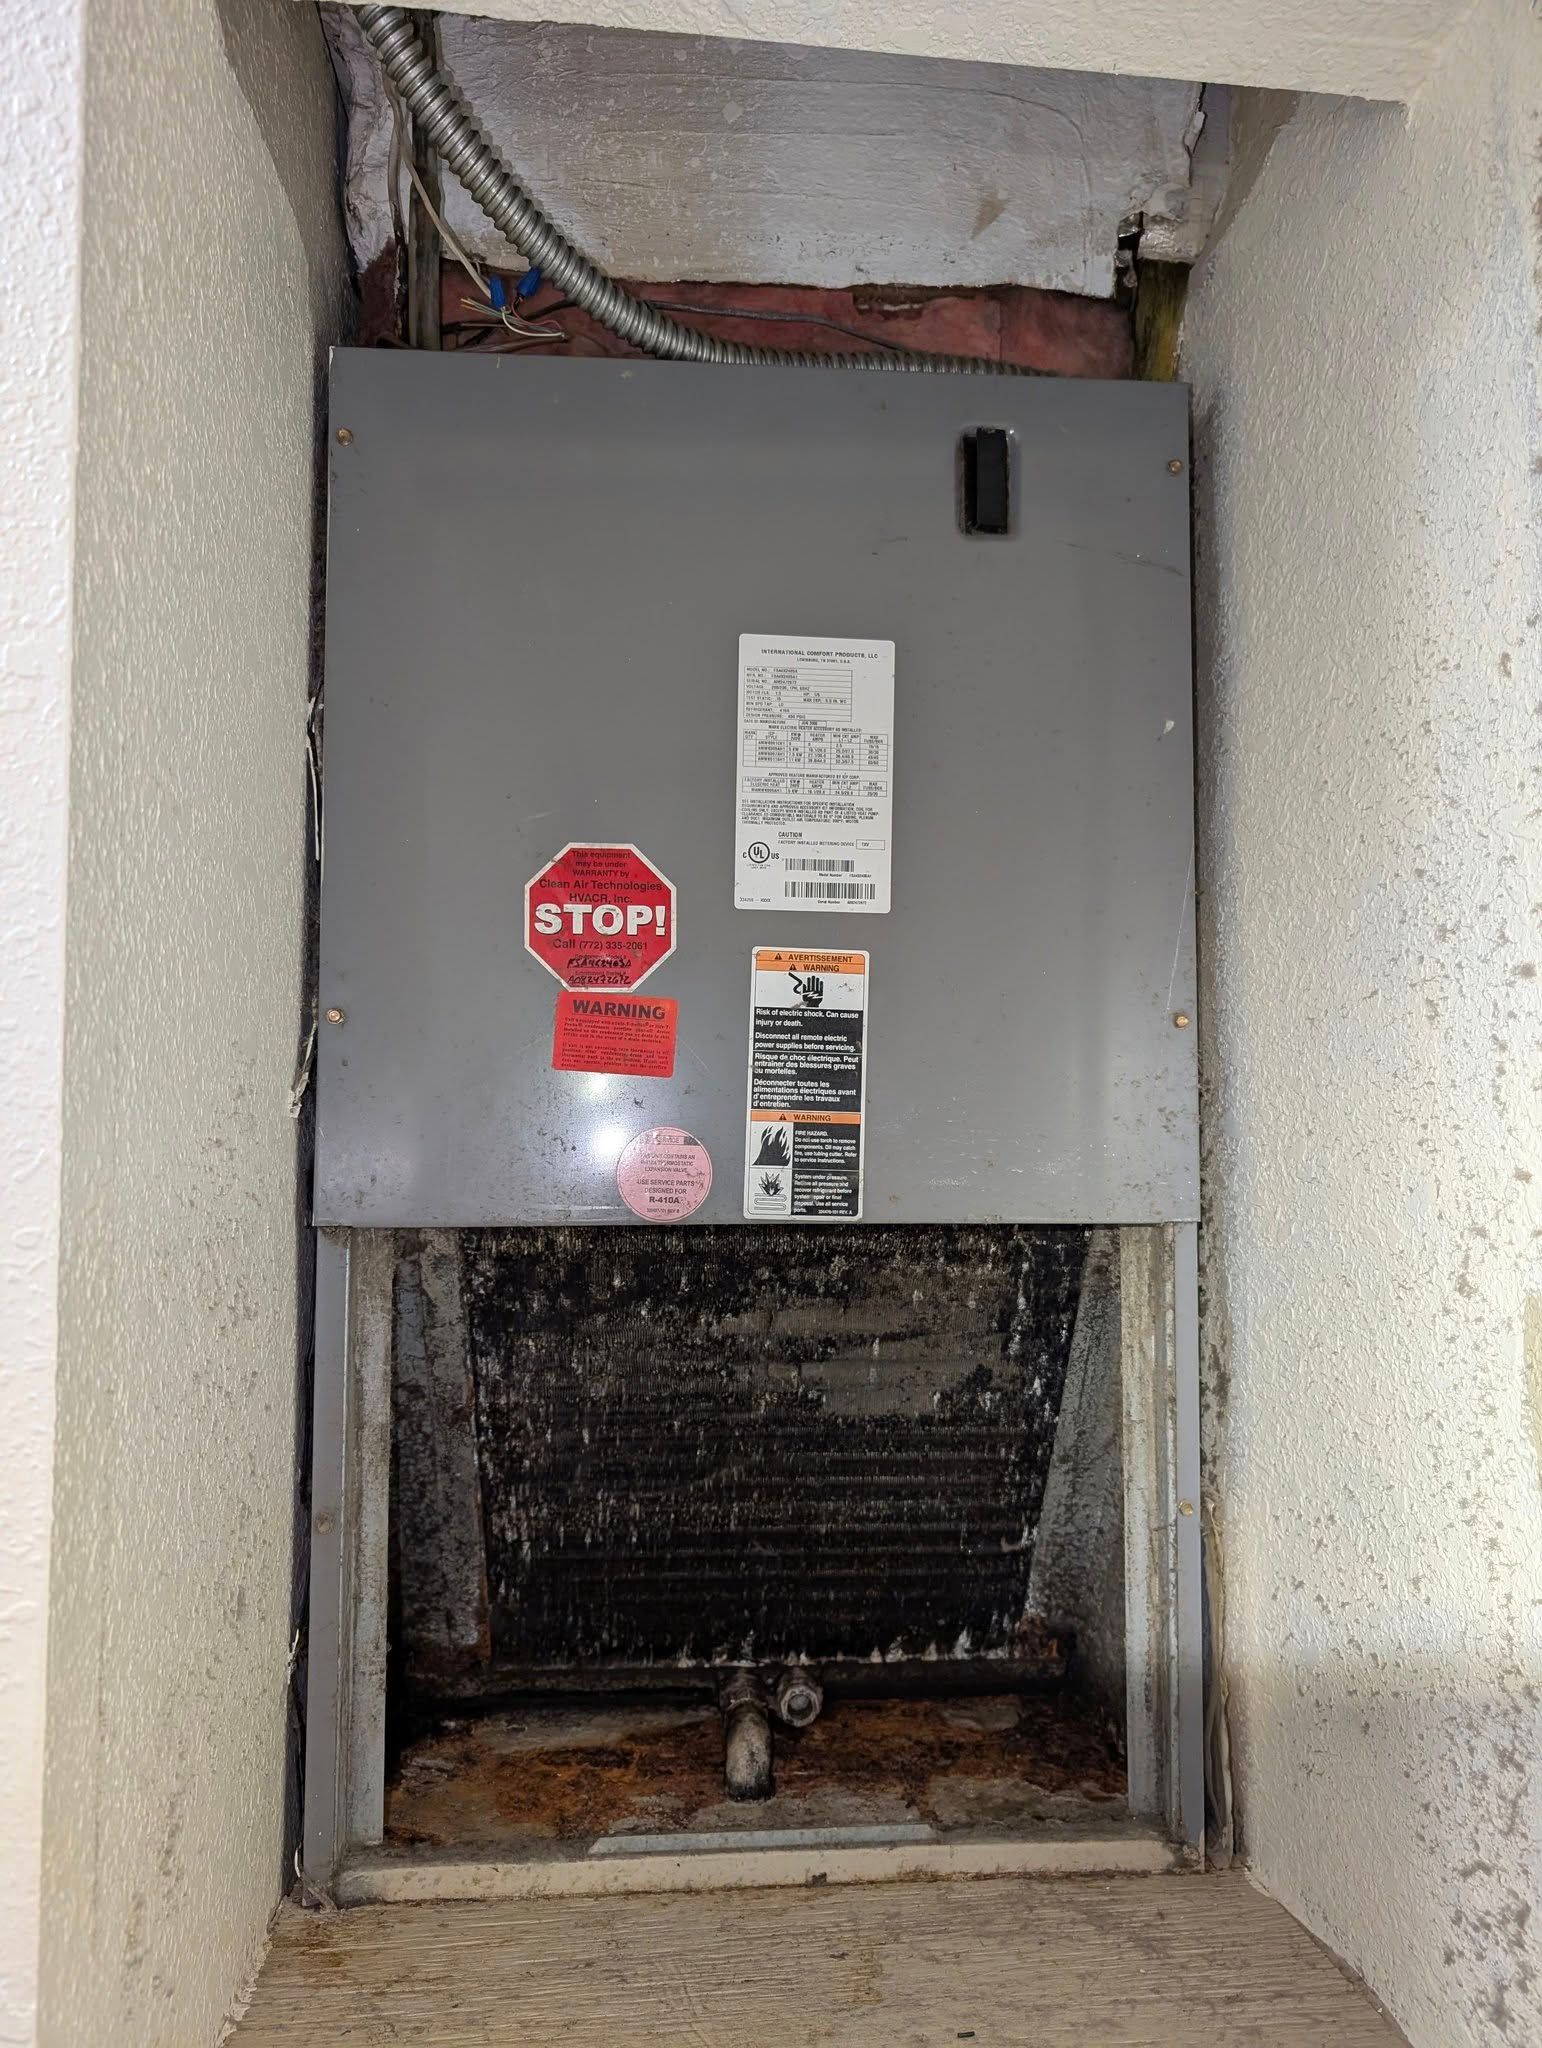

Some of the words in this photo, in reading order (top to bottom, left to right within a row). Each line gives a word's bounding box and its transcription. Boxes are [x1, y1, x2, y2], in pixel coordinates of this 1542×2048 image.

[590, 852, 631, 860] equipment
[753, 846, 764, 859] UL
[539, 880, 570, 889] Clean
[574, 880, 589, 889] Air
[591, 880, 662, 892] Technologies
[569, 893, 611, 904] HVACR,
[534, 903, 666, 936] STOP!
[553, 939, 575, 949] Call
[579, 940, 603, 951] (772)
[605, 942, 648, 950] 335-2061
[788, 954, 853, 963] AVERTISSEMENT
[573, 1000, 665, 1020] WARNING
[800, 1087, 836, 1095] électriques
